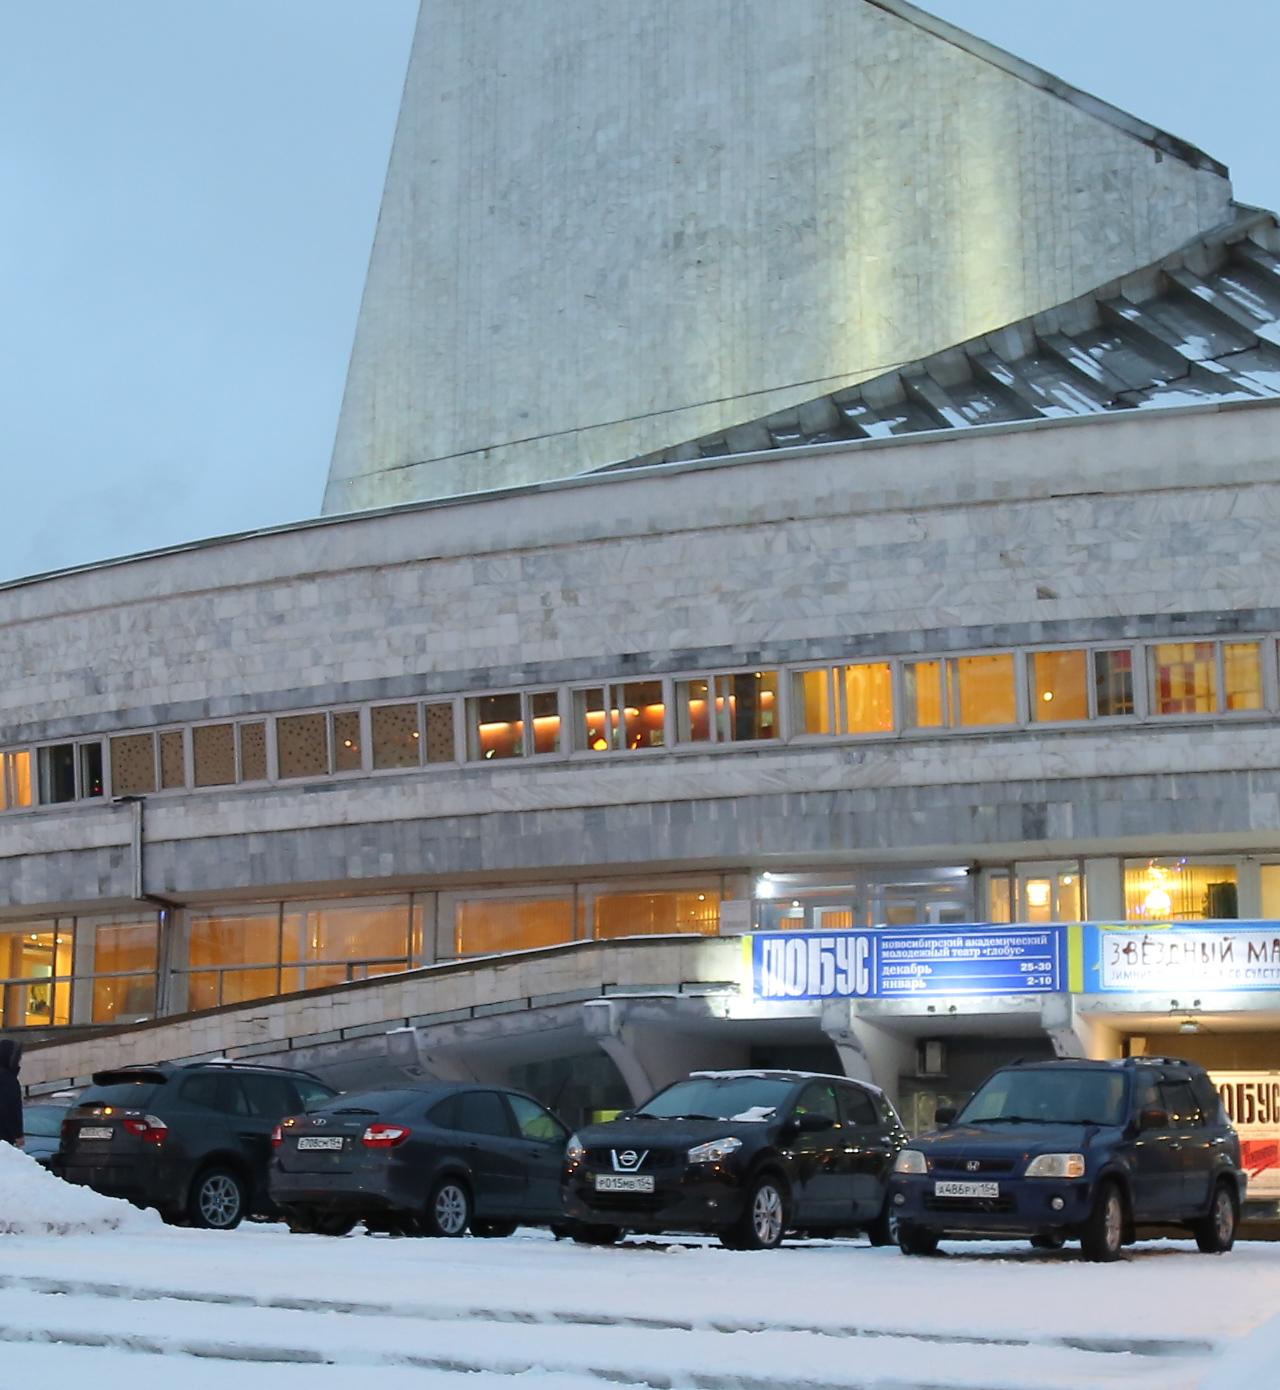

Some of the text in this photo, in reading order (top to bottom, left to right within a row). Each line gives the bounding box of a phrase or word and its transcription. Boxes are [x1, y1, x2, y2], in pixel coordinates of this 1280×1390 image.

[882, 935, 1048, 950] новосибирский академический
[952, 948, 980, 959] театр
[761, 935, 870, 998] ГЛОБУС
[882, 962, 1052, 976] декабрь 25-30
[882, 976, 1052, 990] январь 2-10
[1220, 1082, 1280, 1124] ОБУС
